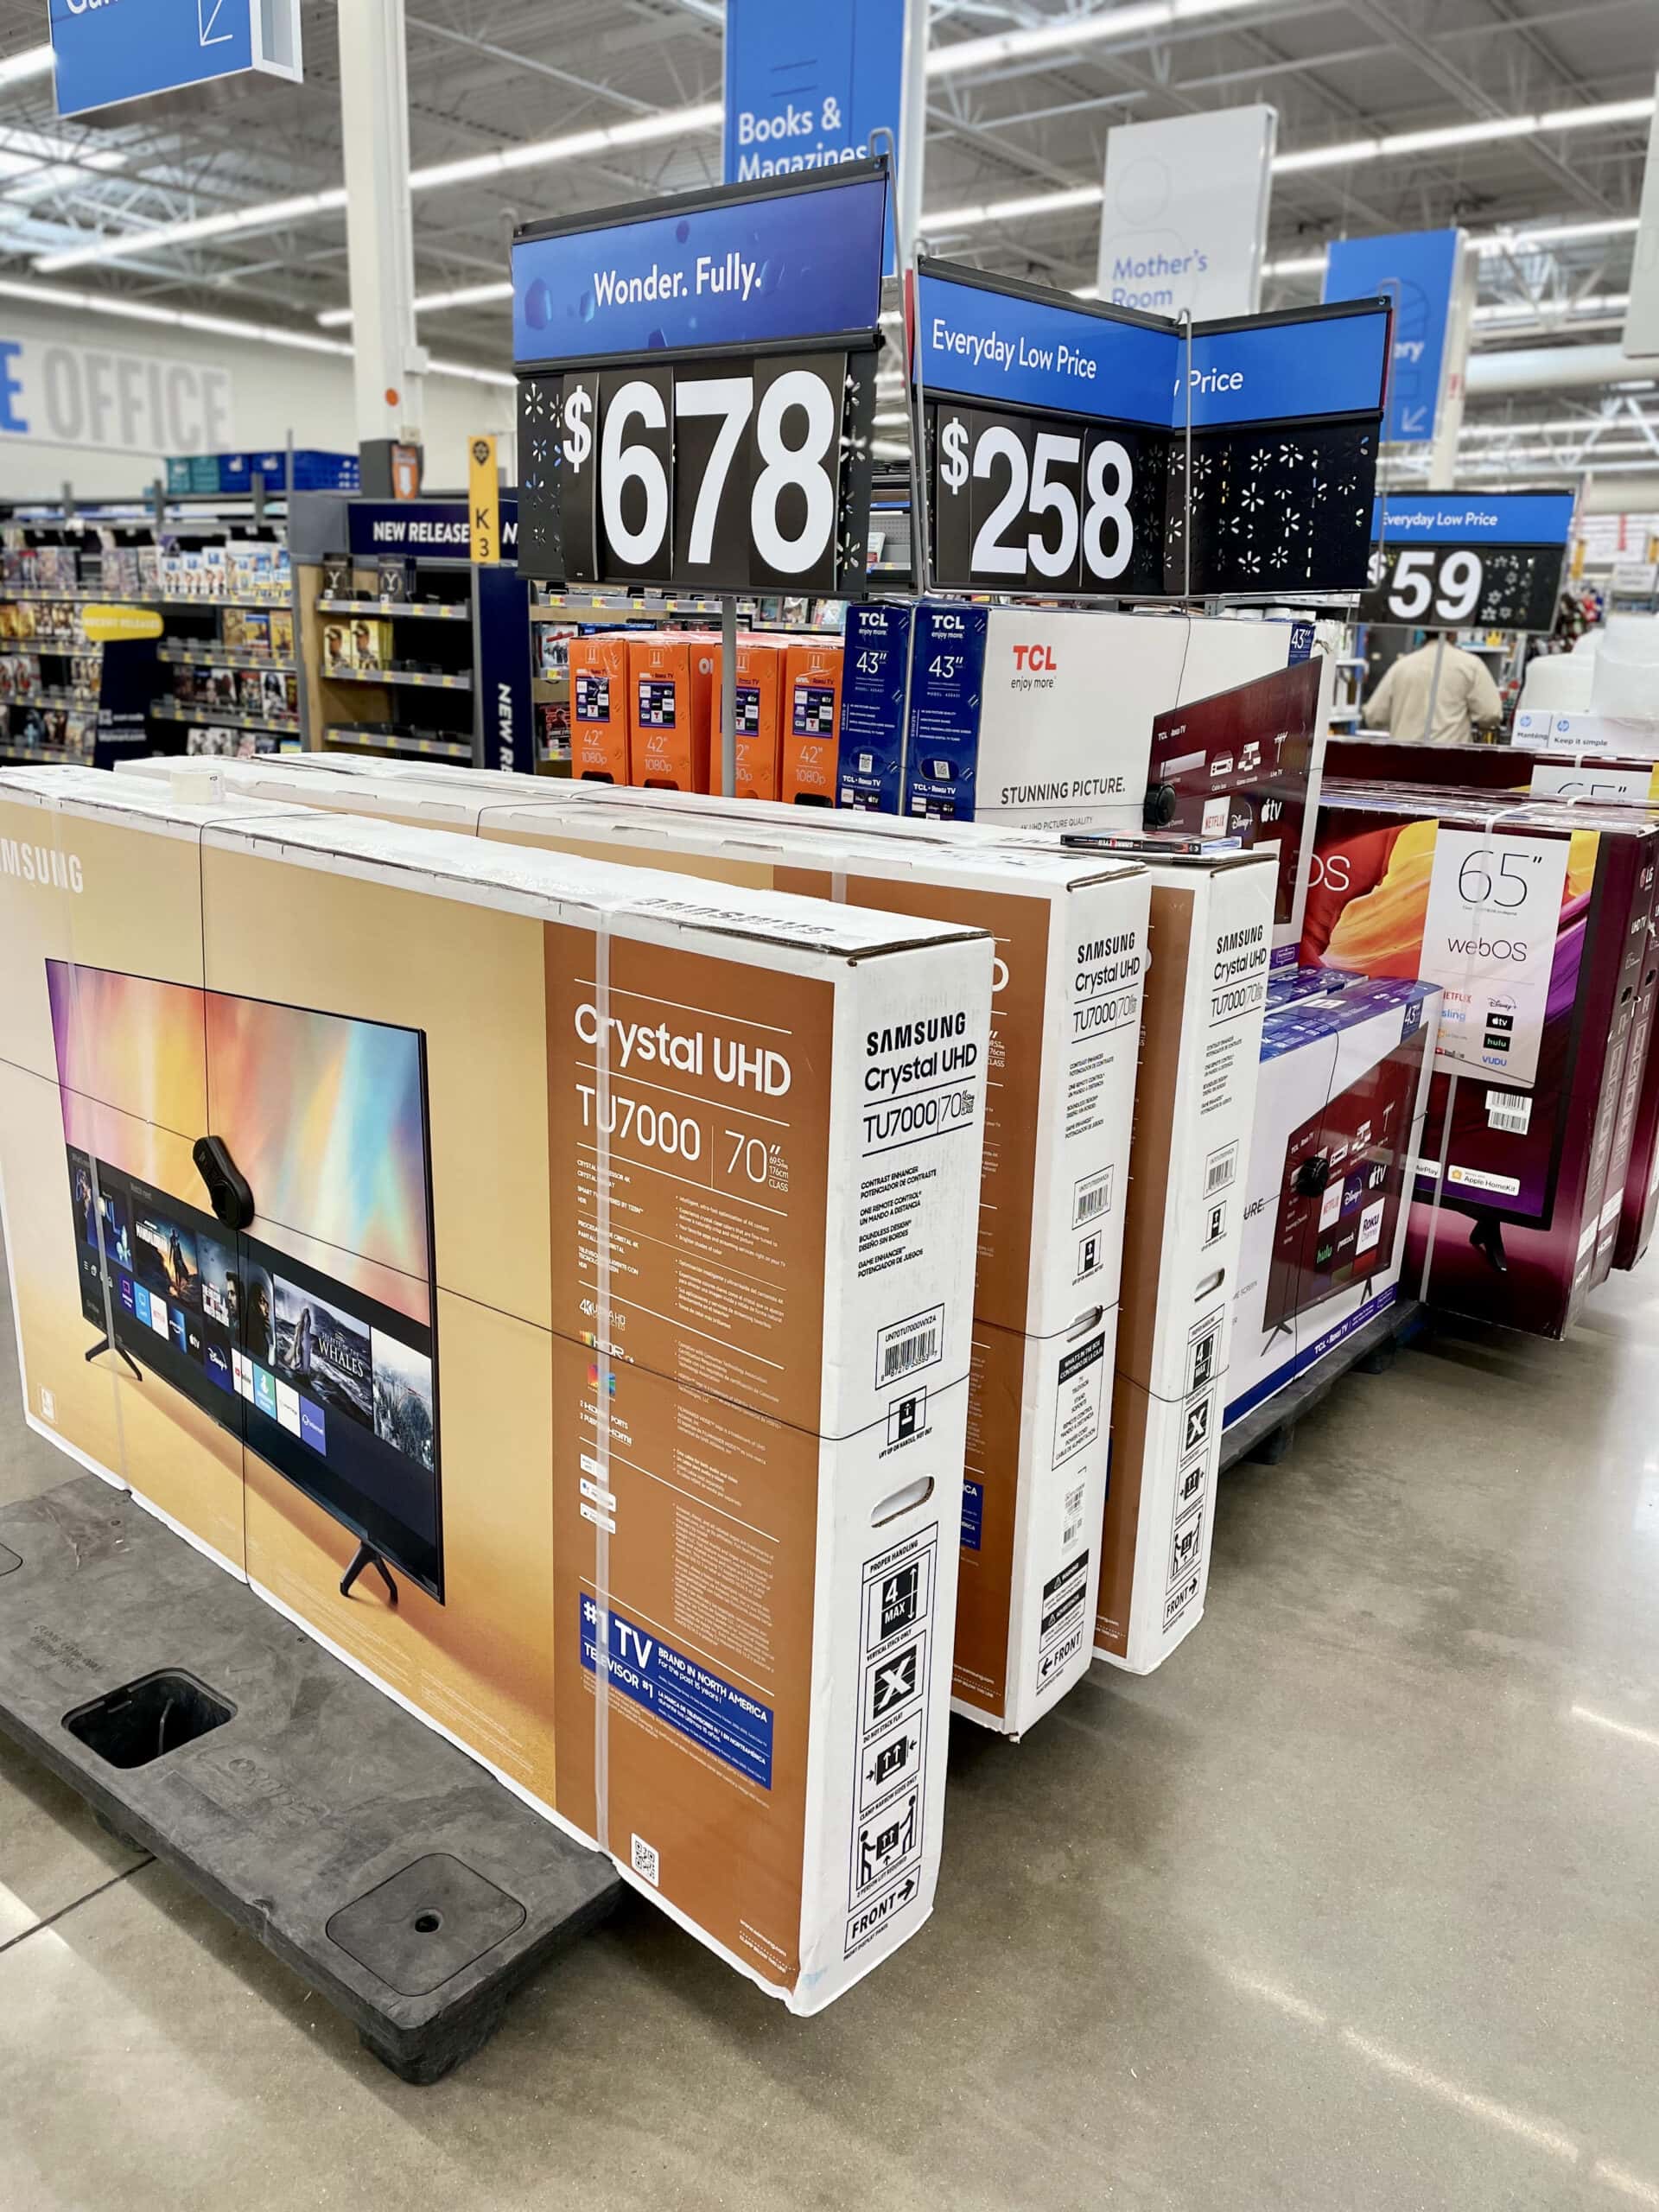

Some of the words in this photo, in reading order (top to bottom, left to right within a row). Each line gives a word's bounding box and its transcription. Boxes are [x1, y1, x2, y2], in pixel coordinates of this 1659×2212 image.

[738, 104, 813, 146] Books
[821, 96, 842, 130] &
[594, 265, 688, 307] Wonder.
[696, 251, 762, 301] Fully.
[1112, 249, 1208, 281] Mother's
[932, 318, 1014, 372] Everyday
[1019, 337, 1052, 371] Low
[1057, 346, 1097, 379] Price
[1189, 367, 1244, 394] Price
[41, 344, 232, 455] OFFICE
[373, 522, 406, 541] NEW
[1437, 512, 1465, 526] Low
[1465, 512, 1498, 526] Price
[859, 613, 888, 627] TCL
[931, 614, 964, 630] TCL
[931, 631, 947, 640] enjoy
[1013, 644, 1057, 671] TCL
[1011, 675, 1033, 691] enjoy
[498, 683, 513, 743] NEW
[1554, 737, 1573, 746] Keep
[1001, 782, 1068, 805] STUNNING
[1072, 776, 1126, 797] PICTURE.
[1069, 816, 1093, 827] QUALITY
[1459, 849, 1542, 907] 65"
[1077, 931, 1135, 964] SAMSUNG
[1217, 925, 1263, 955] SAMSUNG
[1448, 937, 1528, 962] webOS
[1075, 962, 1118, 995] Crystal
[1120, 957, 1141, 979] UHD
[1213, 953, 1249, 982] Crystal
[1249, 948, 1267, 969] UHD
[1073, 1001, 1116, 1033] TU7000
[1211, 988, 1245, 1018] TU7000
[1441, 1008, 1466, 1022] sling
[574, 1002, 703, 1076] Crystal
[713, 1036, 791, 1096] UHD
[867, 1011, 966, 1057] SAMSUNG
[1487, 1037, 1507, 1047] hulu
[864, 1052, 938, 1095] Crystal
[942, 1043, 977, 1072] UHD
[1482, 1055, 1507, 1066] VUDU
[575, 1084, 701, 1161] TU7000
[862, 1099, 938, 1143] TU7000
[768, 1166, 788, 1179] 176cm
[768, 1179, 788, 1192] CLASS
[861, 1174, 891, 1190] CONTRAST
[1464, 1175, 1484, 1186] Apple
[317, 1337, 364, 1378] WHALES
[869, 1554, 892, 1573] PROPER
[885, 1578, 899, 1603] 4
[1166, 1586, 1189, 1618] FRONT
[884, 1600, 906, 1624] MAX
[614, 1618, 653, 1669] TV
[1053, 1630, 1081, 1667] FRONT
[658, 1646, 686, 1671] BRAND
[686, 1663, 696, 1678] IN
[697, 1671, 728, 1698] NORTH
[728, 1691, 767, 1724] AMERICA
[701, 1686, 719, 1702] years
[851, 1891, 897, 1939] FRONT
